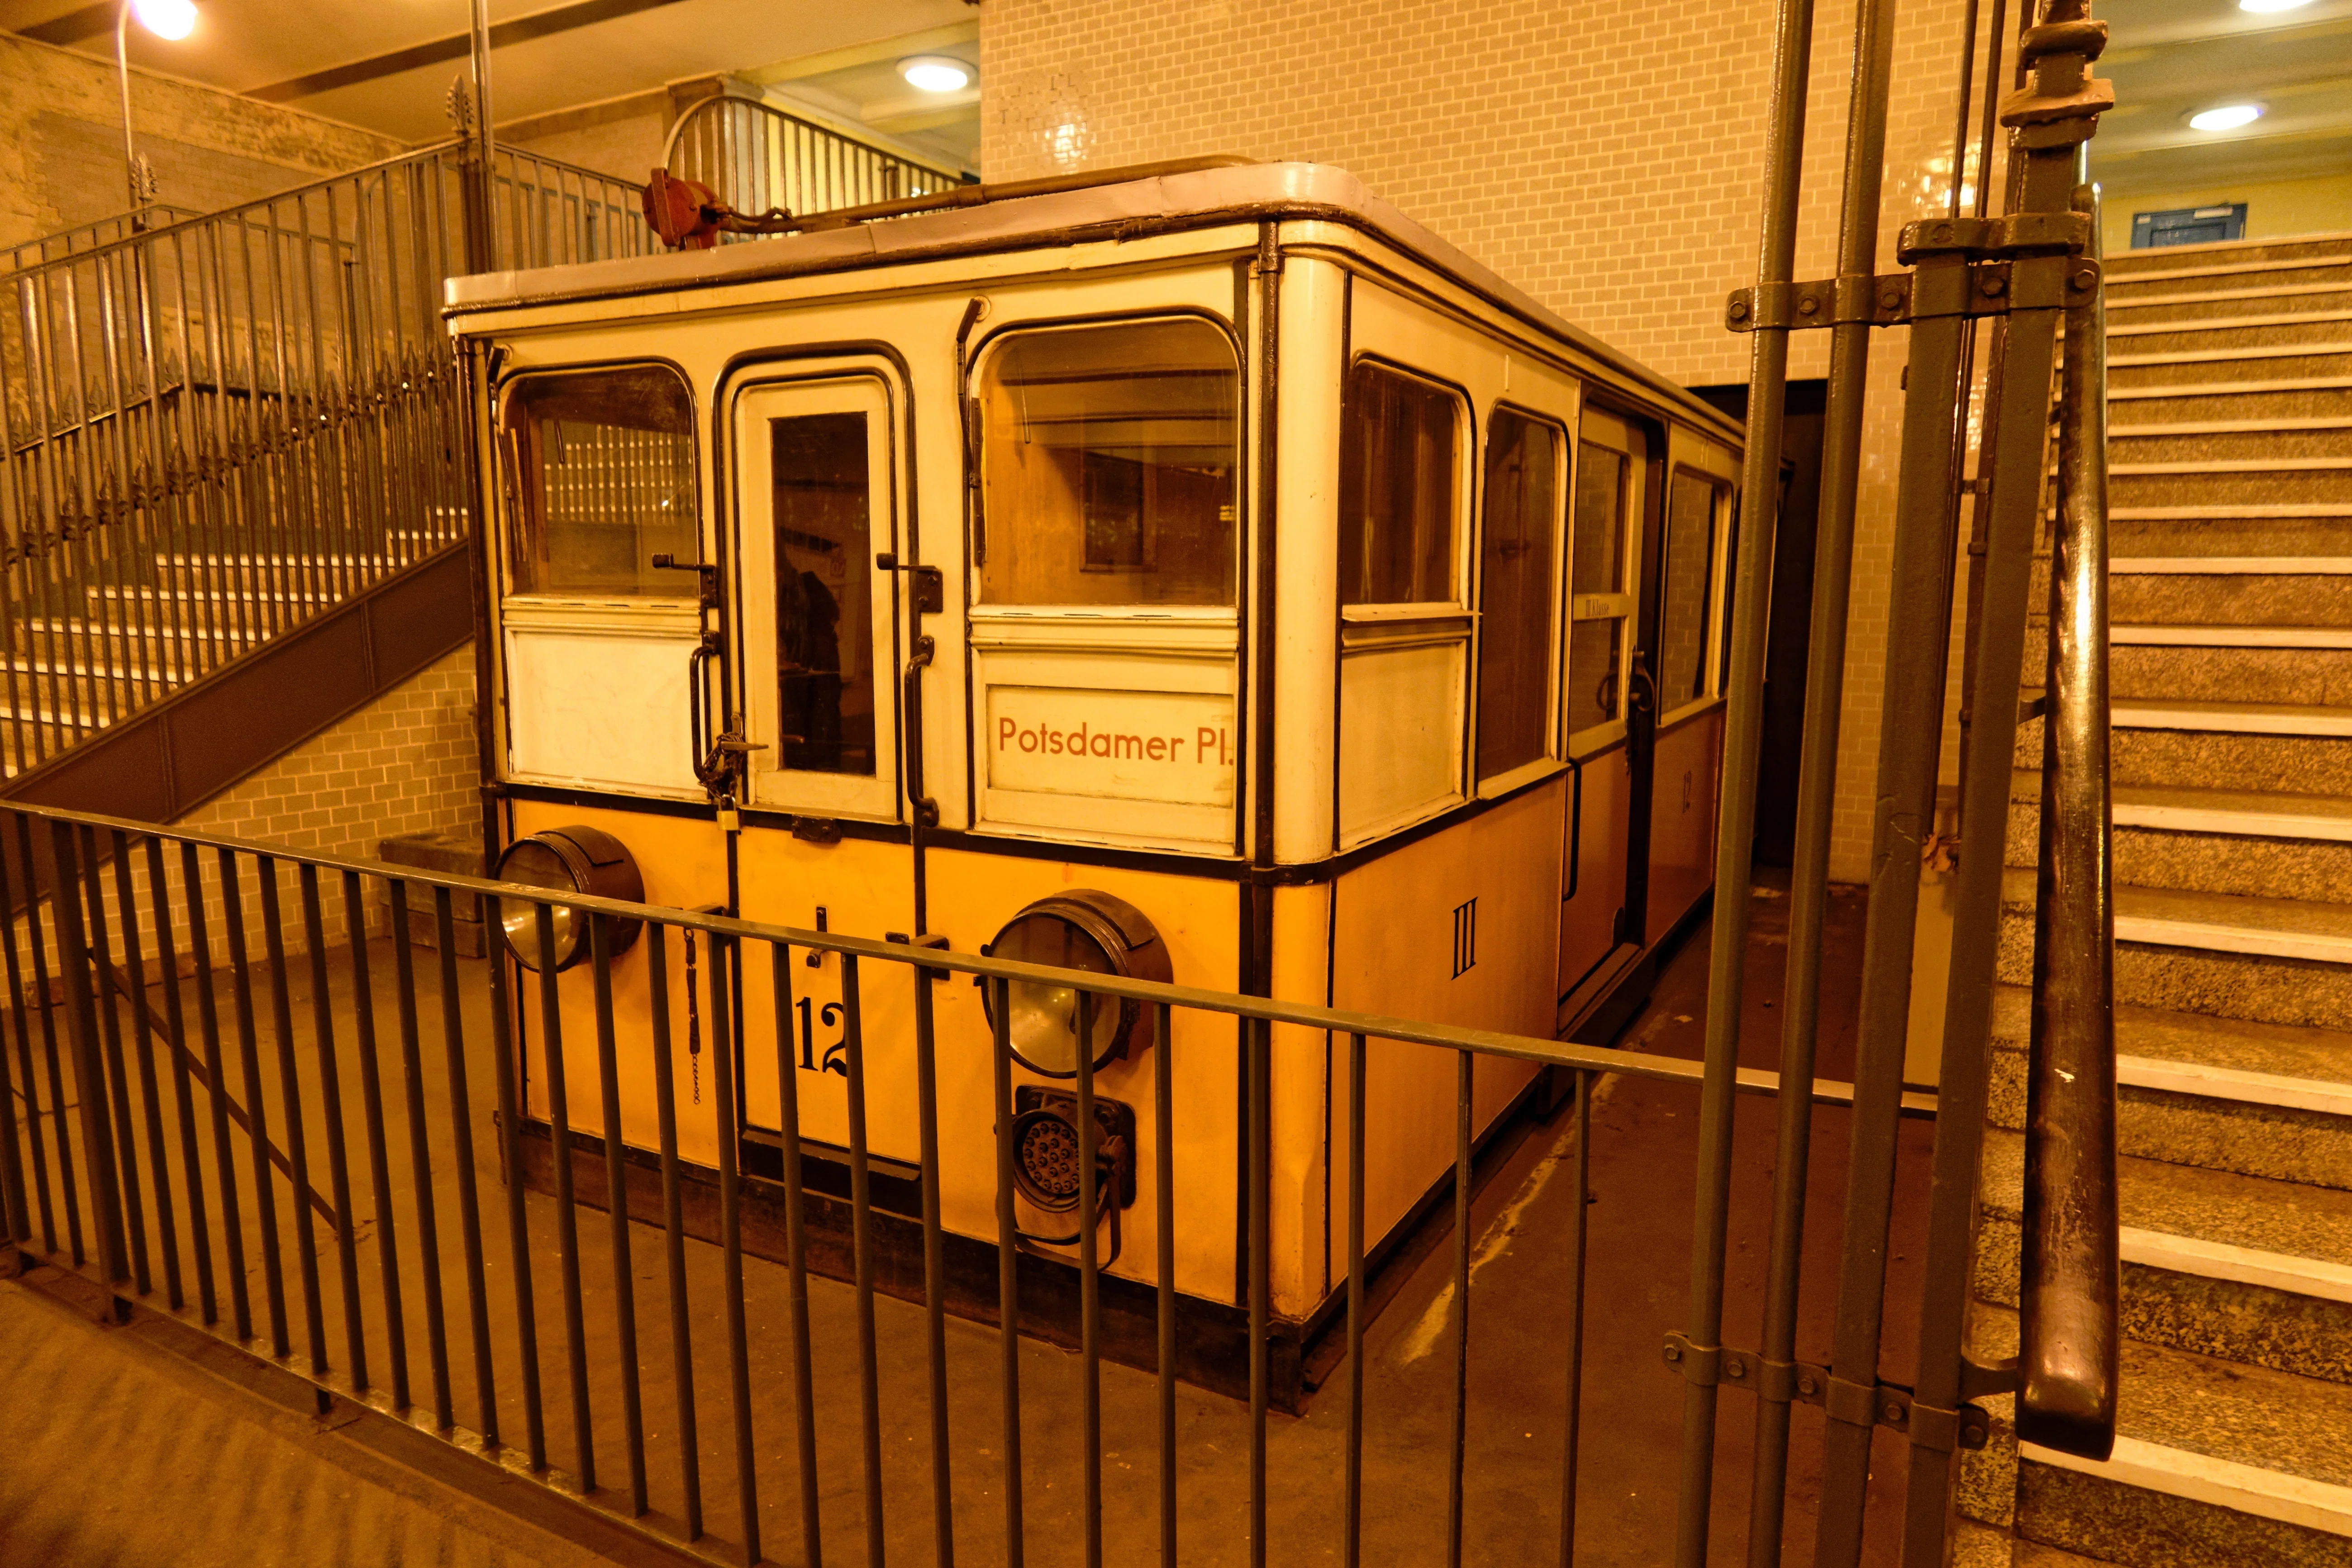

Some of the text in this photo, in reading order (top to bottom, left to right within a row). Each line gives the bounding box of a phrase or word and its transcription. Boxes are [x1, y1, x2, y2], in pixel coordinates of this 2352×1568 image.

[999, 717, 1233, 766] Potsdamer Pl.
[1451, 896, 1478, 981] III
[795, 996, 847, 1078] 12
